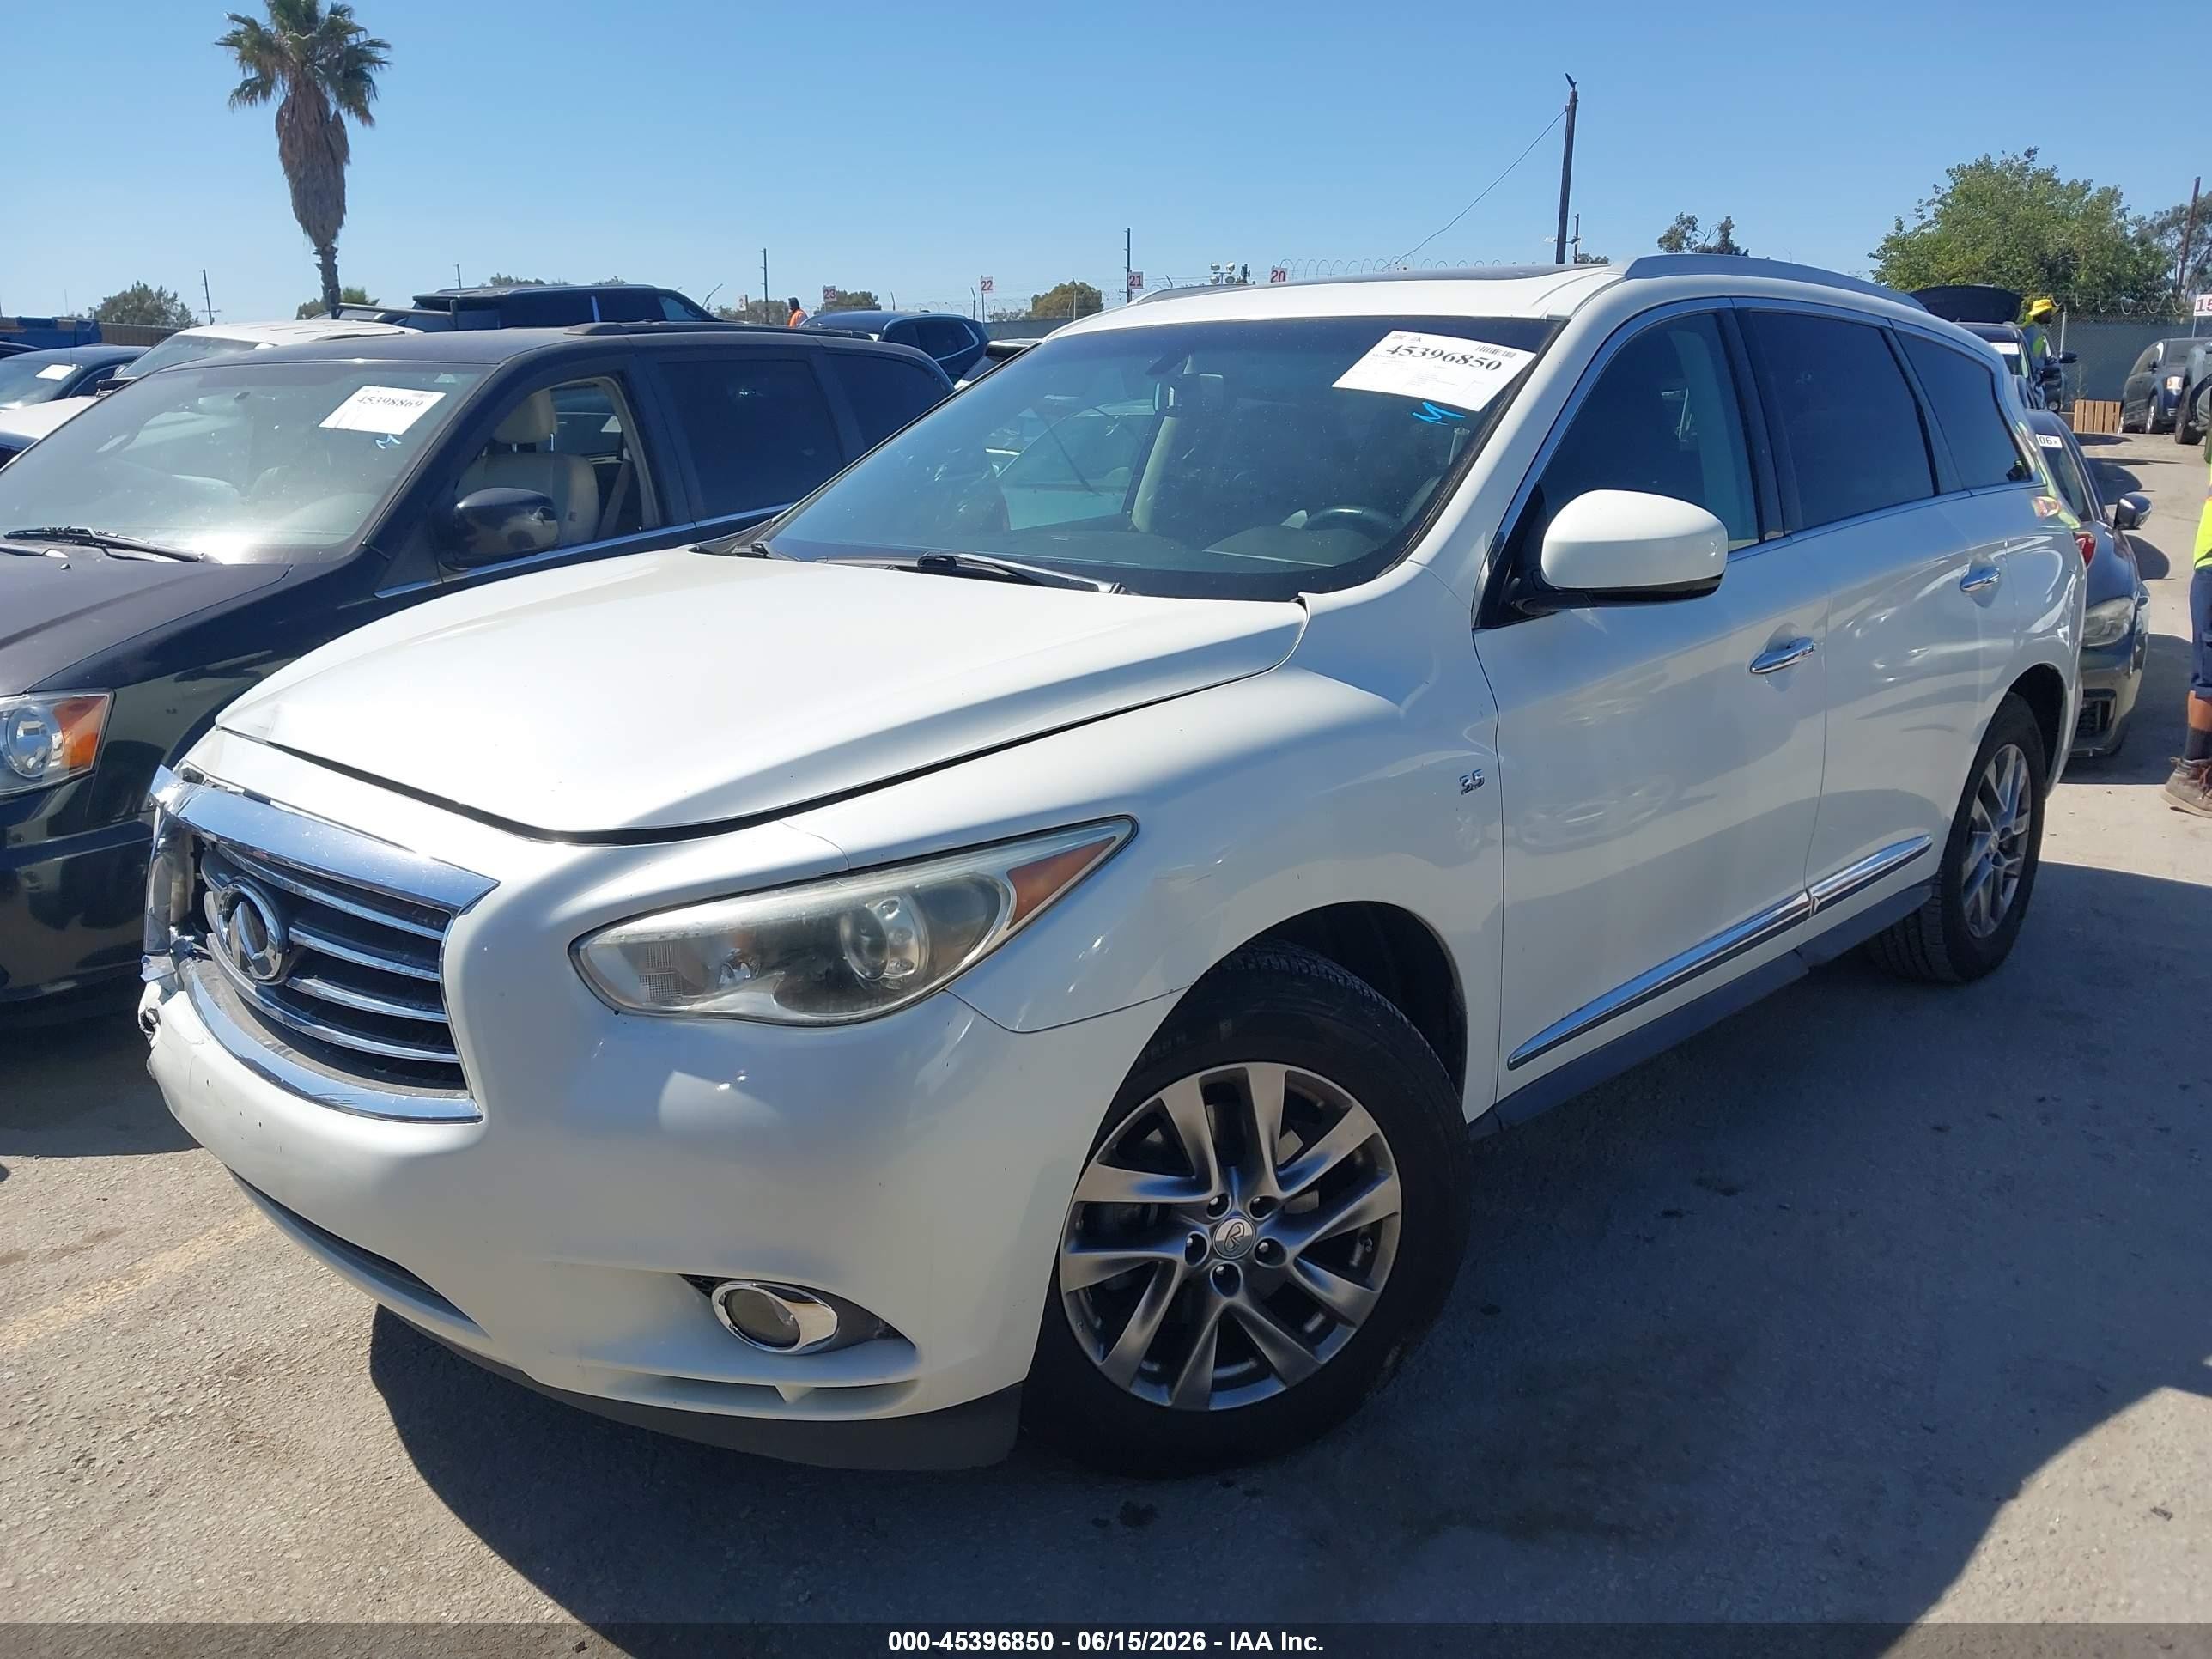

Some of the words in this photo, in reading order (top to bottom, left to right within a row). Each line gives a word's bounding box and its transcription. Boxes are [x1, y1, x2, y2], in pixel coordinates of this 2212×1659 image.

[1128, 275, 1142, 287] 21
[1271, 270, 1286, 283] 20
[981, 280, 994, 291] 22
[823, 289, 836, 299] 23
[1385, 344, 1503, 371] 45396850
